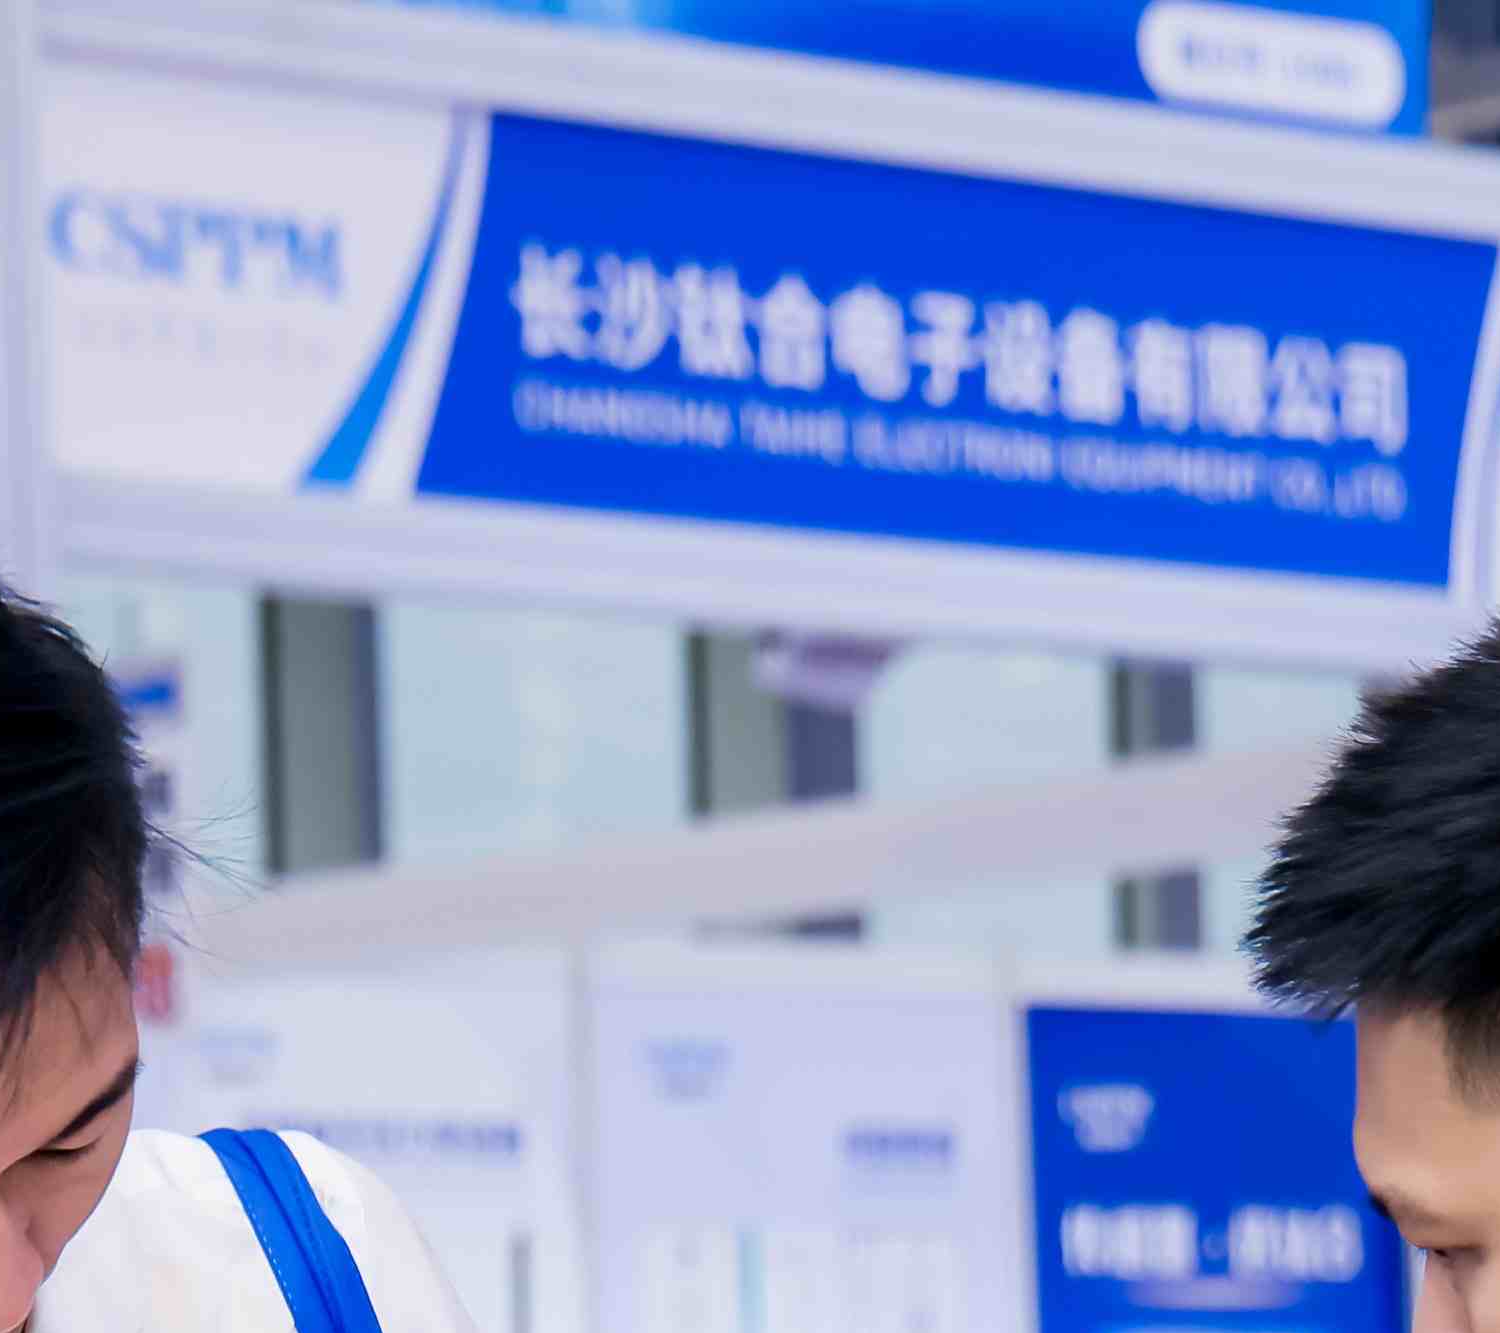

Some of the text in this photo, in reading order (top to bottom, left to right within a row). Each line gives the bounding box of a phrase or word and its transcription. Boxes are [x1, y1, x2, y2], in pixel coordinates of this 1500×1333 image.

[45, 185, 346, 300] CSPPM
[510, 242, 1410, 456] 长沙钛合电子设备有限公司
[513, 376, 732, 450] CHANGSHA
